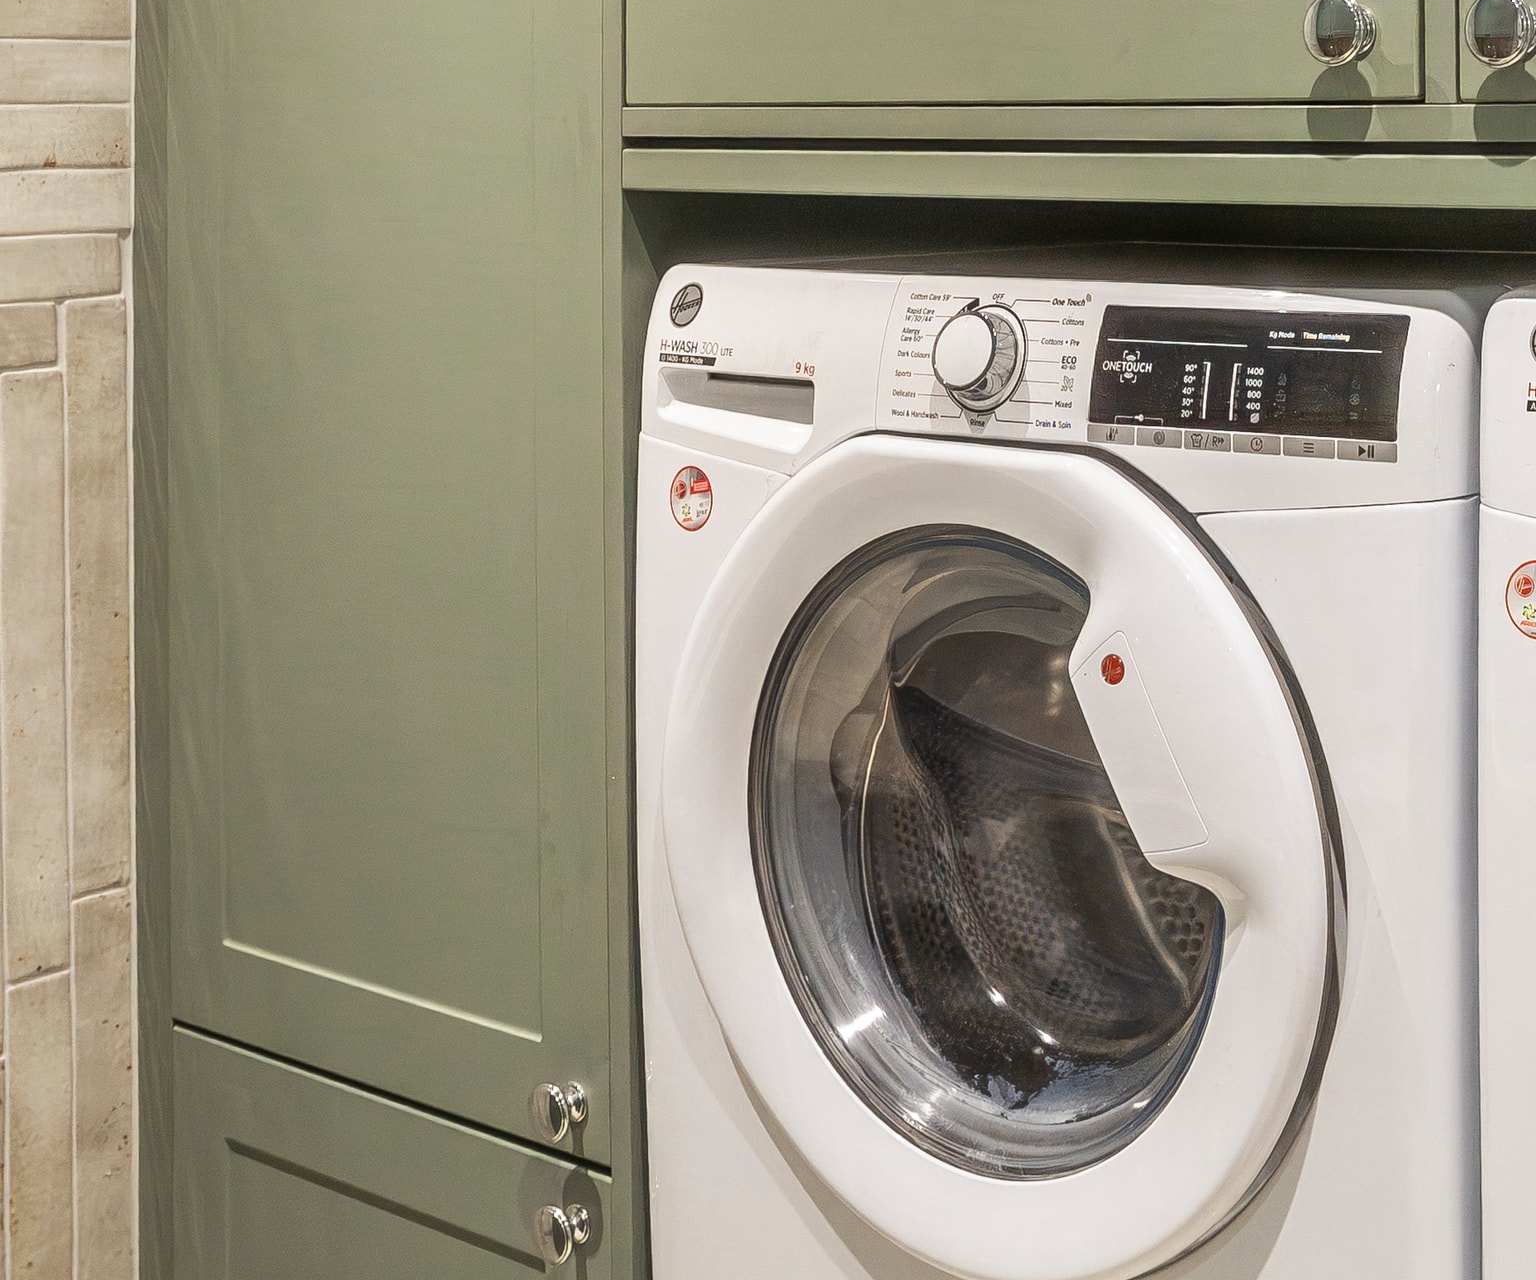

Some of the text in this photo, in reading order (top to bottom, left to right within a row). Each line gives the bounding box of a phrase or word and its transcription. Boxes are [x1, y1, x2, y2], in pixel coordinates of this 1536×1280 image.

[929, 293, 941, 301] Care
[1052, 298, 1086, 306] One Touch
[907, 307, 922, 315] Rapid
[1062, 318, 1084, 326] Cottons
[902, 327, 920, 336] Allergy
[1268, 330, 1296, 340] Kg Mode
[900, 334, 912, 342] Care
[1303, 331, 1350, 342] Time Remaining
[1041, 338, 1064, 346] Cottons
[660, 339, 698, 354] H-WASH
[700, 342, 718, 356] 300
[1061, 356, 1077, 364] ECO
[795, 362, 816, 376] 9 kg
[1102, 360, 1152, 374] ONETOUCH
[894, 369, 912, 378] Sports
[1247, 368, 1264, 376] 1400
[1246, 379, 1262, 388] 1000
[892, 389, 916, 398] Delicates
[1247, 390, 1262, 399] 800
[1054, 400, 1072, 408] Mixed
[1246, 402, 1260, 410] 400
[911, 410, 939, 419] Handwash
[970, 418, 985, 427] Rinse
[1036, 419, 1051, 428] Drain
[1058, 421, 1072, 430] Spin
